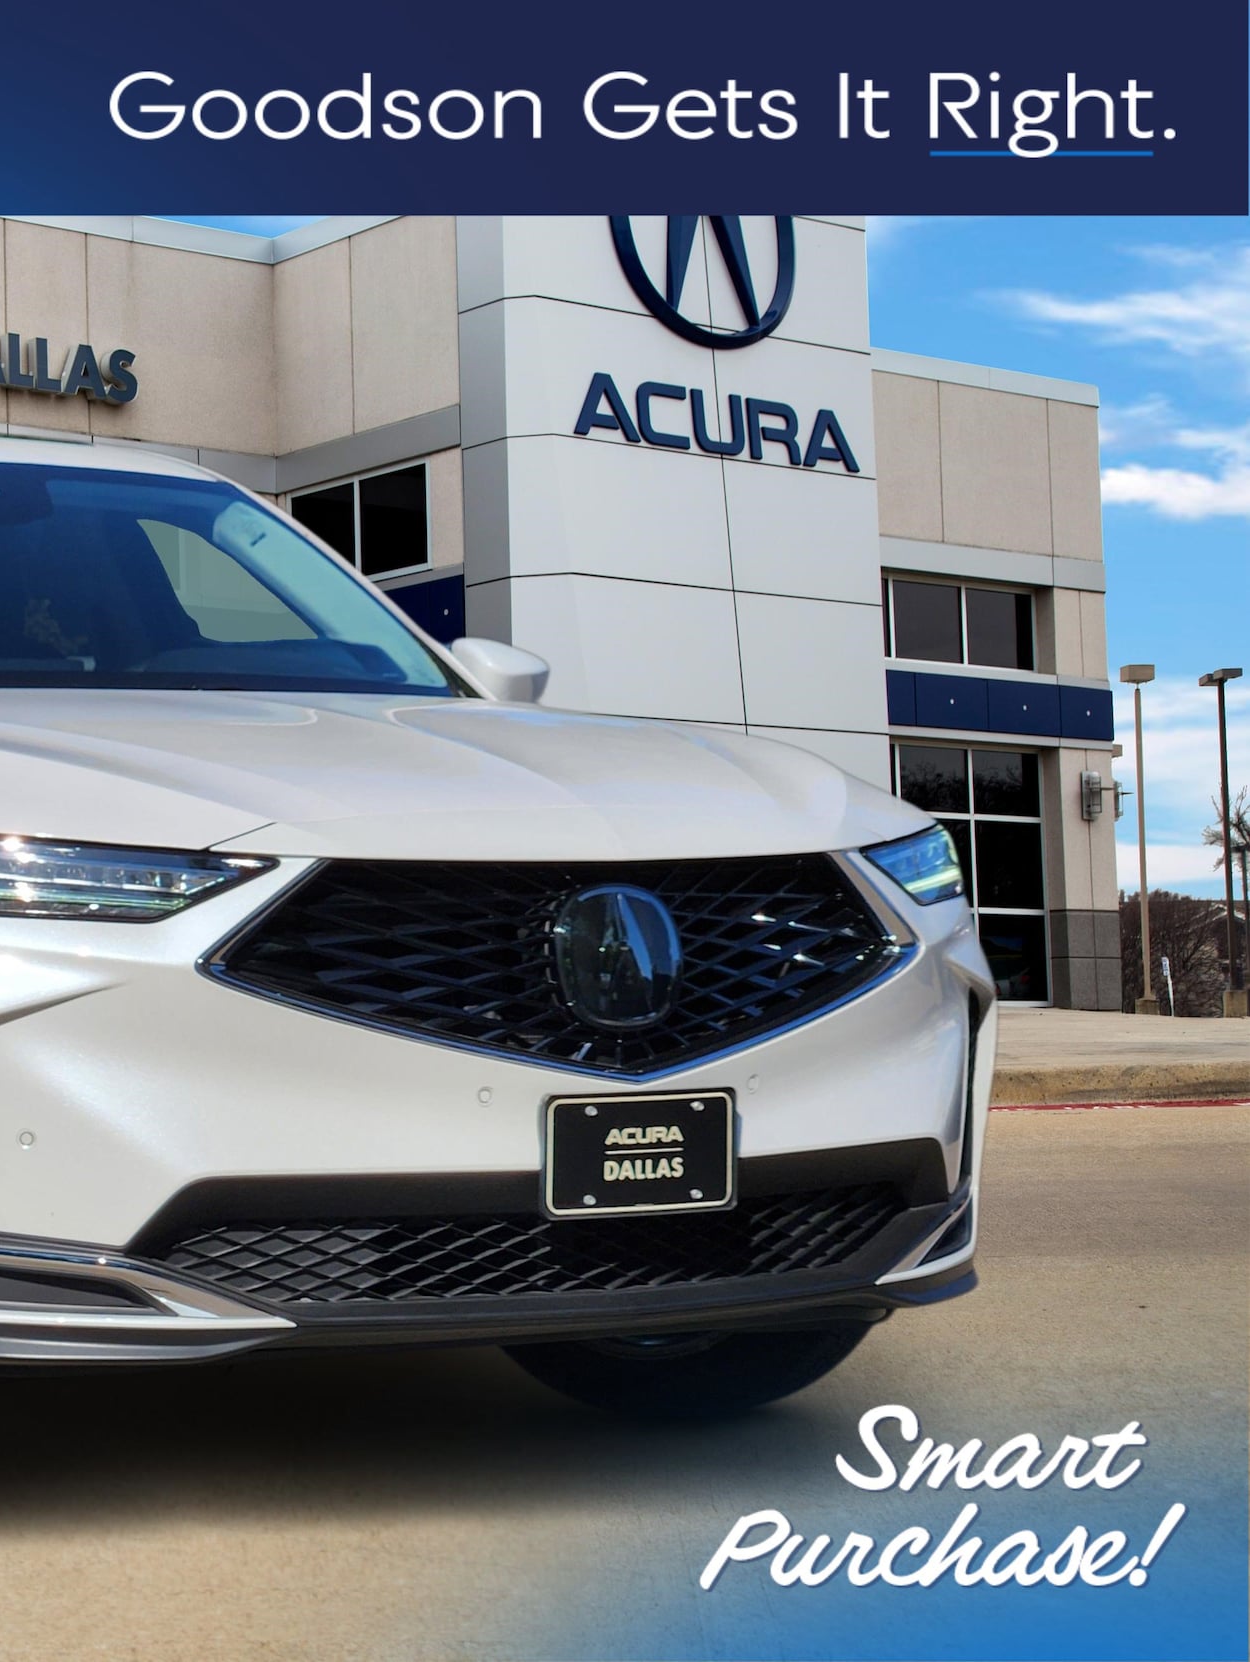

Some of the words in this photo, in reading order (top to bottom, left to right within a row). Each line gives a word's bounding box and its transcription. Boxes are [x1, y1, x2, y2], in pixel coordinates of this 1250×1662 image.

[573, 371, 860, 473] ACURA
[604, 1126, 684, 1146] ACURA
[603, 1157, 684, 1181] DALLAS
